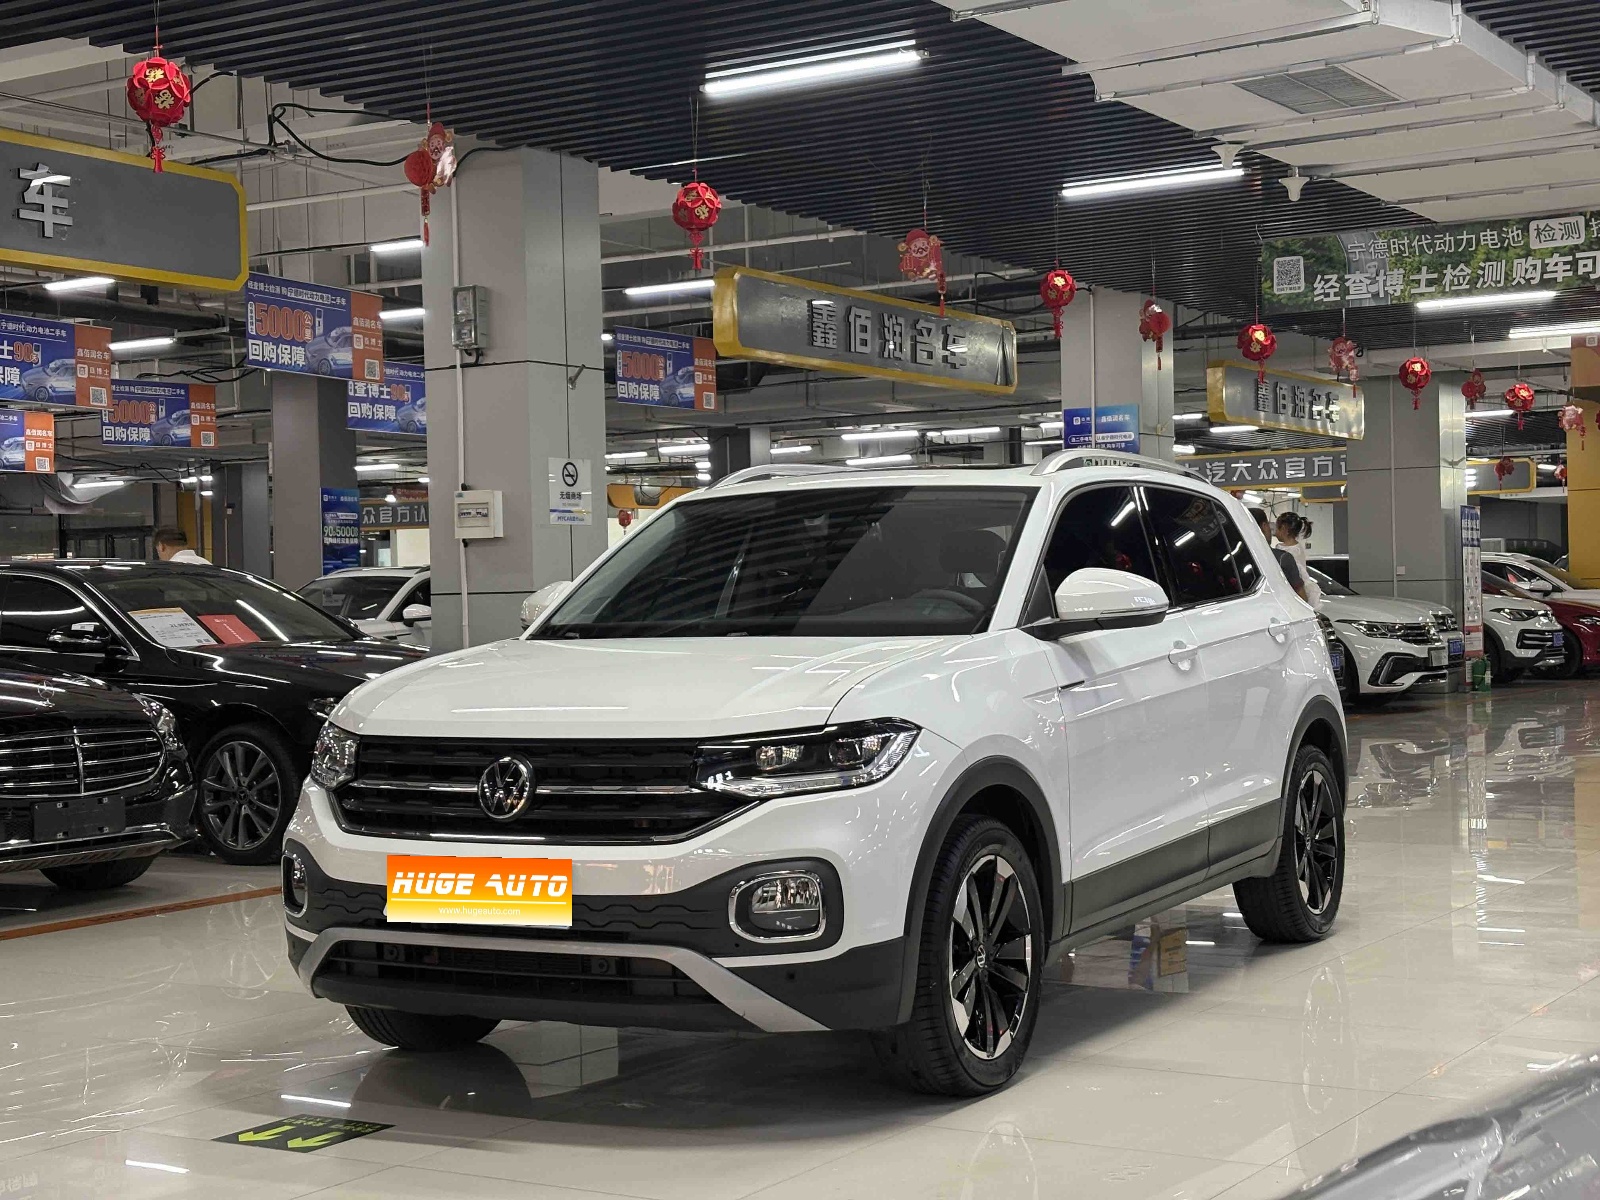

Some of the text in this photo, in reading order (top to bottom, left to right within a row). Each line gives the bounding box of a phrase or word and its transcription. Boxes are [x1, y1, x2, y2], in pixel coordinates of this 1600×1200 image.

[18, 163, 73, 237] 车
[1347, 226, 1524, 261] 宁德时代动力电池
[1534, 220, 1581, 243] 检测
[809, 299, 968, 369] 鑫佰润名车
[248, 339, 306, 367] 回购保障
[617, 381, 660, 401] 回购保障
[347, 402, 396, 421] 回购保障
[102, 426, 151, 442] 回购保障
